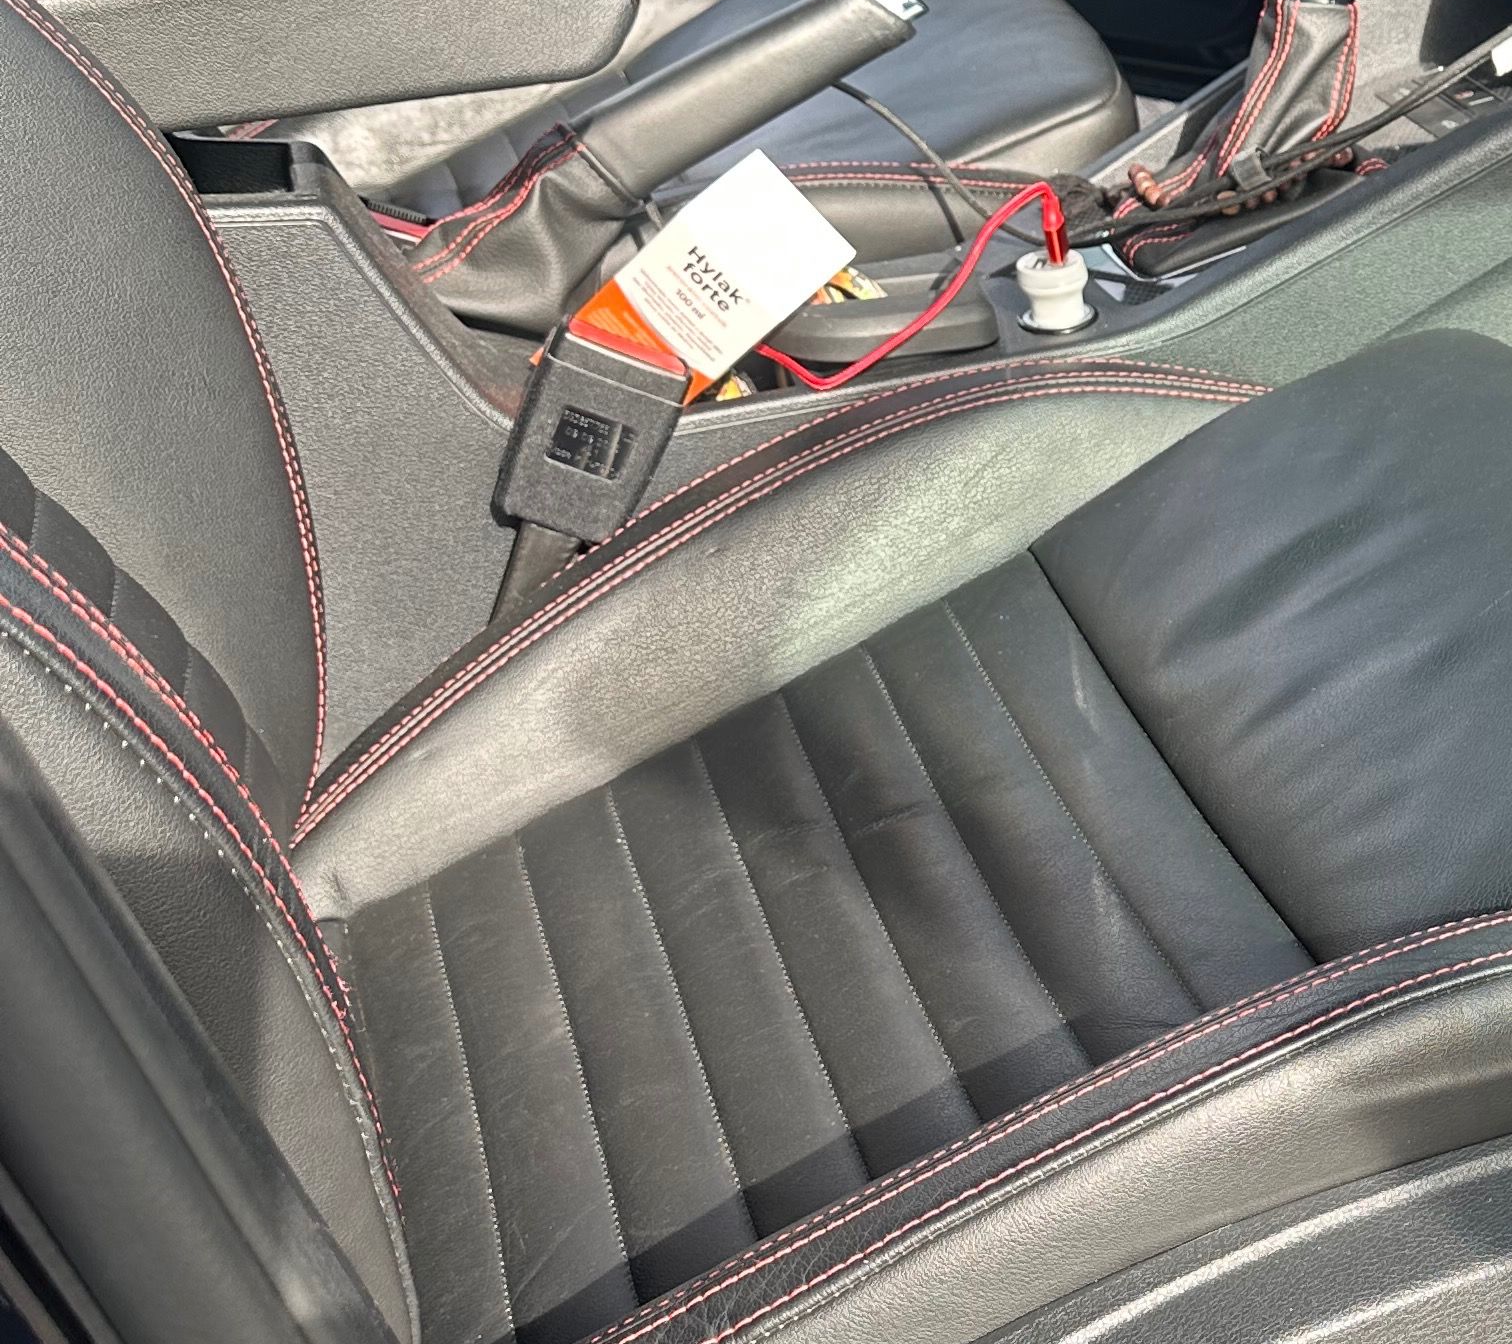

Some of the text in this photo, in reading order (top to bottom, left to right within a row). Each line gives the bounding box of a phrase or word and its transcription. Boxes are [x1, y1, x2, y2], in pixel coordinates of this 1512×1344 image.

[676, 288, 693, 307] 100
[683, 262, 730, 312] forte
[687, 245, 744, 305] Hylak
